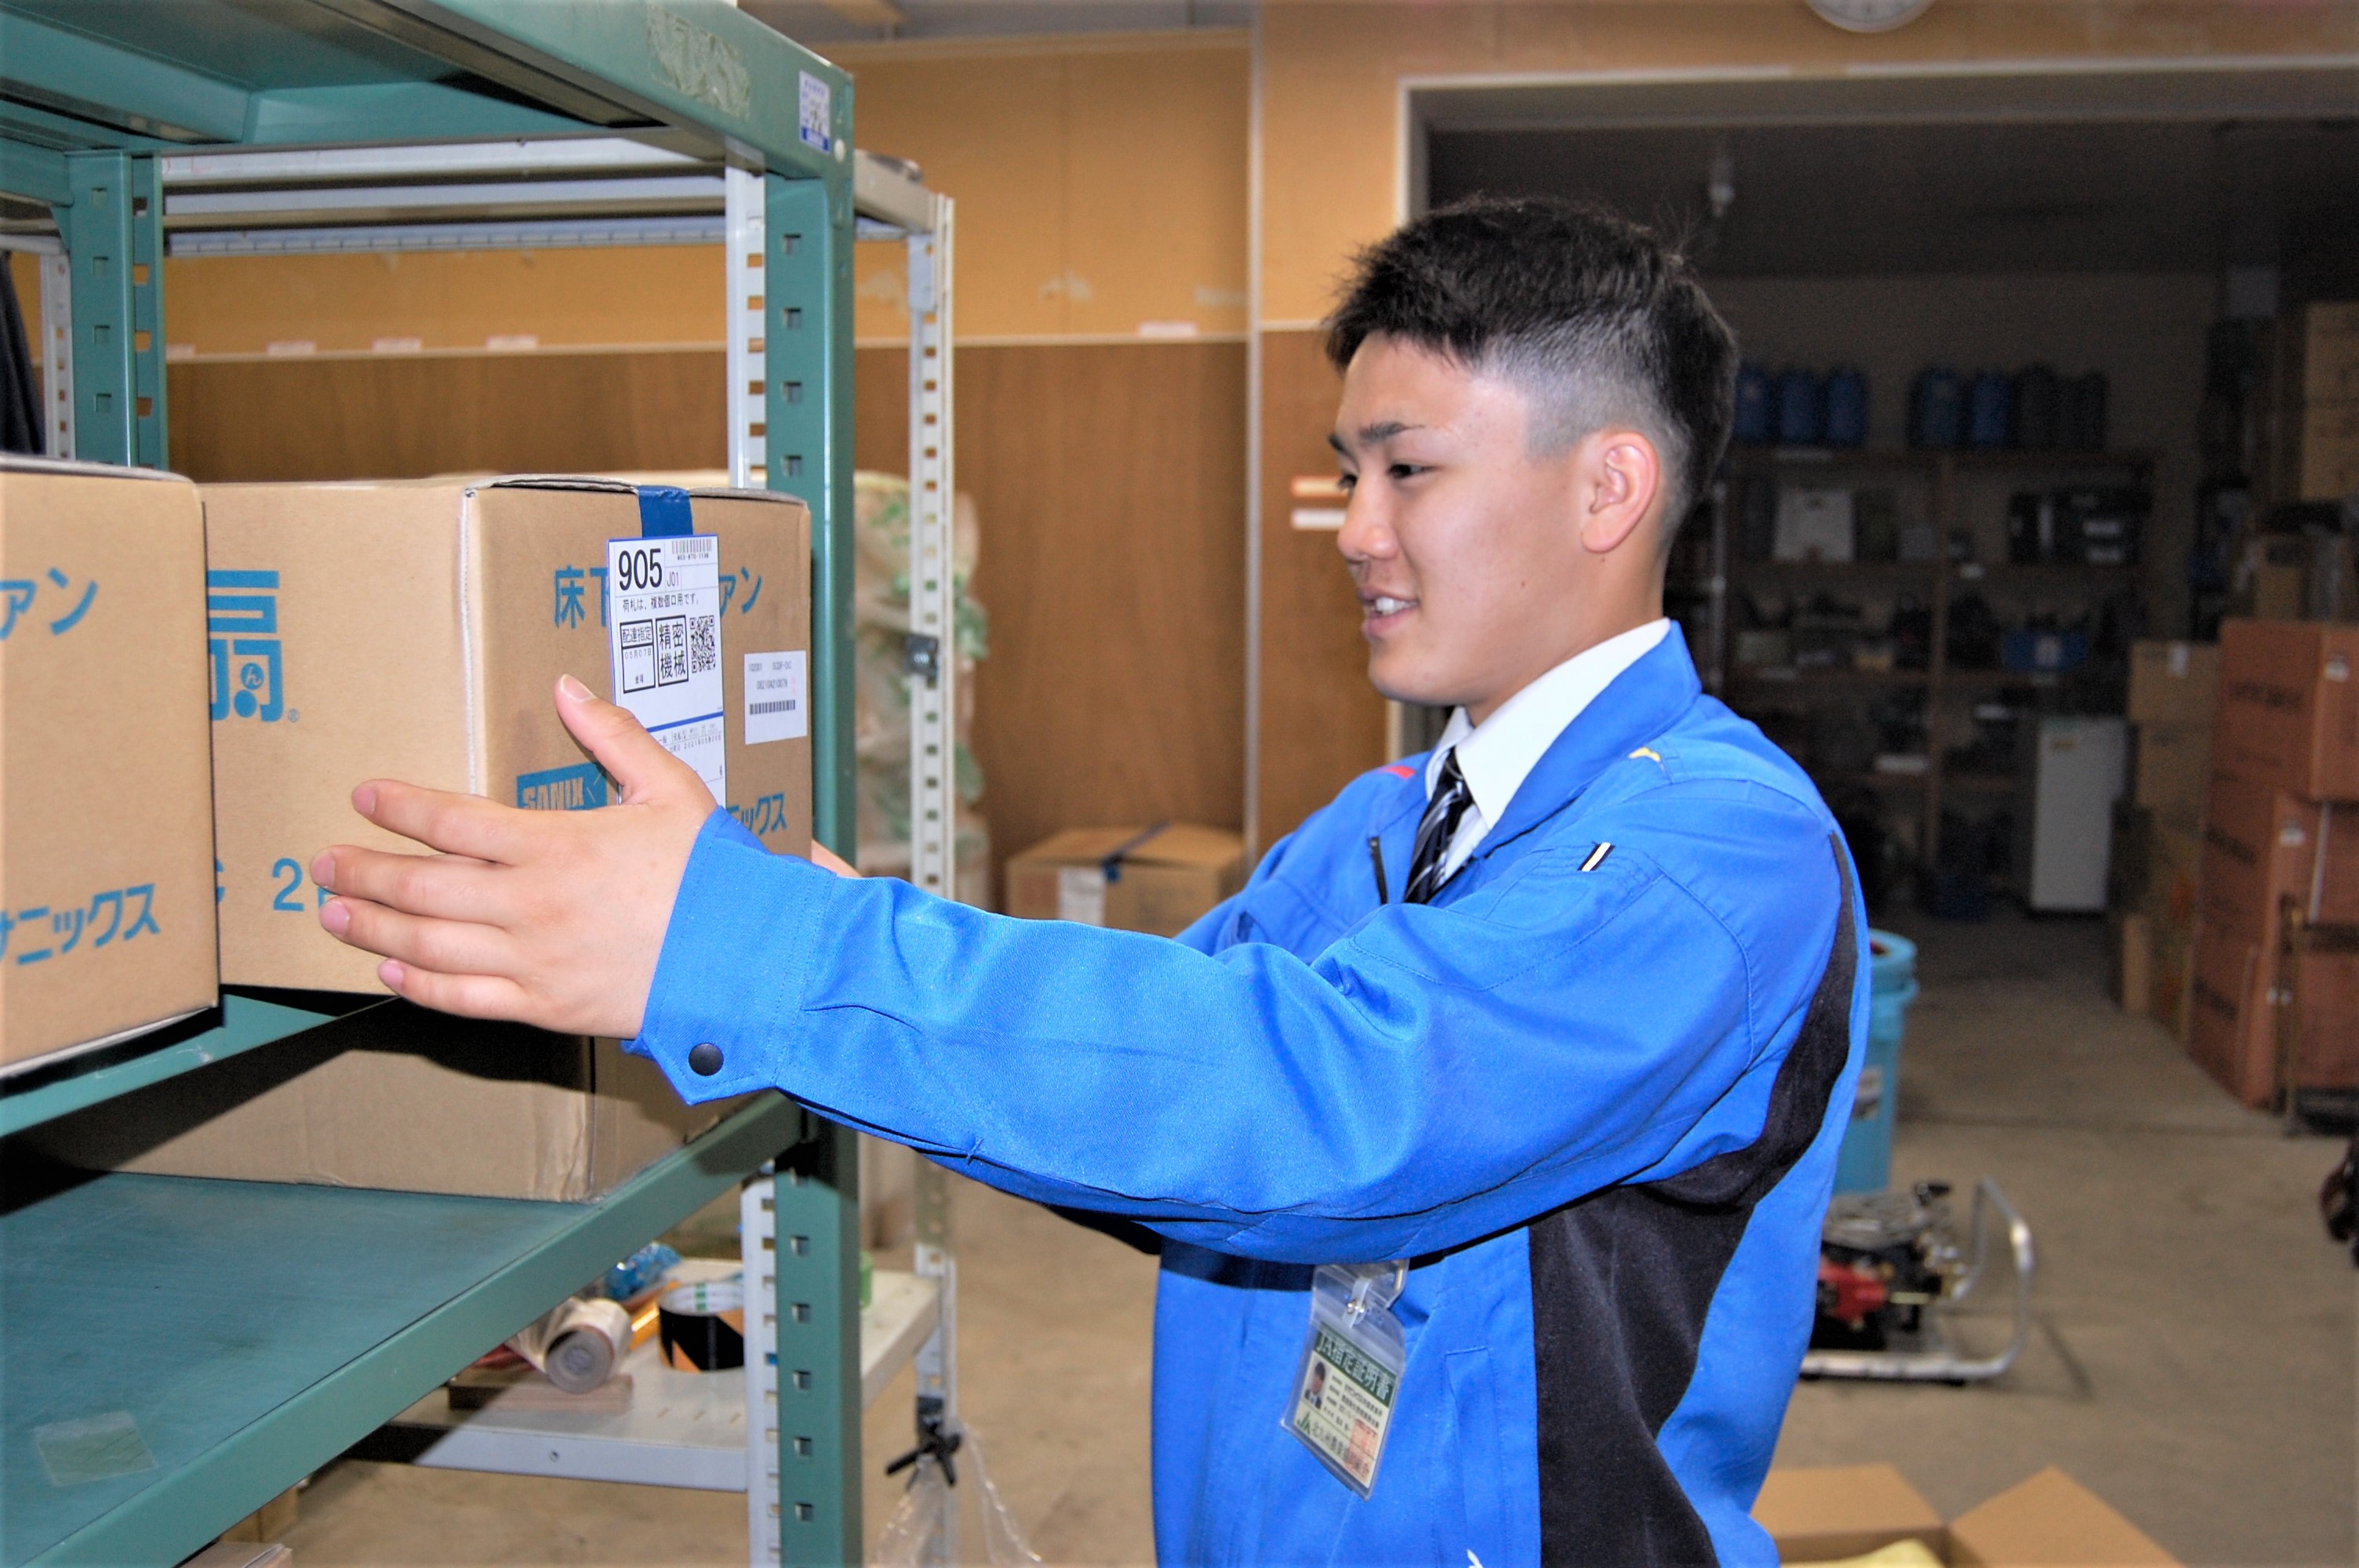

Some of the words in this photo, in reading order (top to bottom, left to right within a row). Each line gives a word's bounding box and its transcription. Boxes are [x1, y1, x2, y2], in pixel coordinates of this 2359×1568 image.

[618, 547, 663, 591] 905
[667, 571, 679, 587] J01
[622, 593, 699, 613] 荷札は、複数個口用です。
[622, 626, 652, 644] 配達指定
[659, 621, 684, 650] 精密
[660, 649, 686, 680] 機械
[523, 777, 584, 810] SANIX
